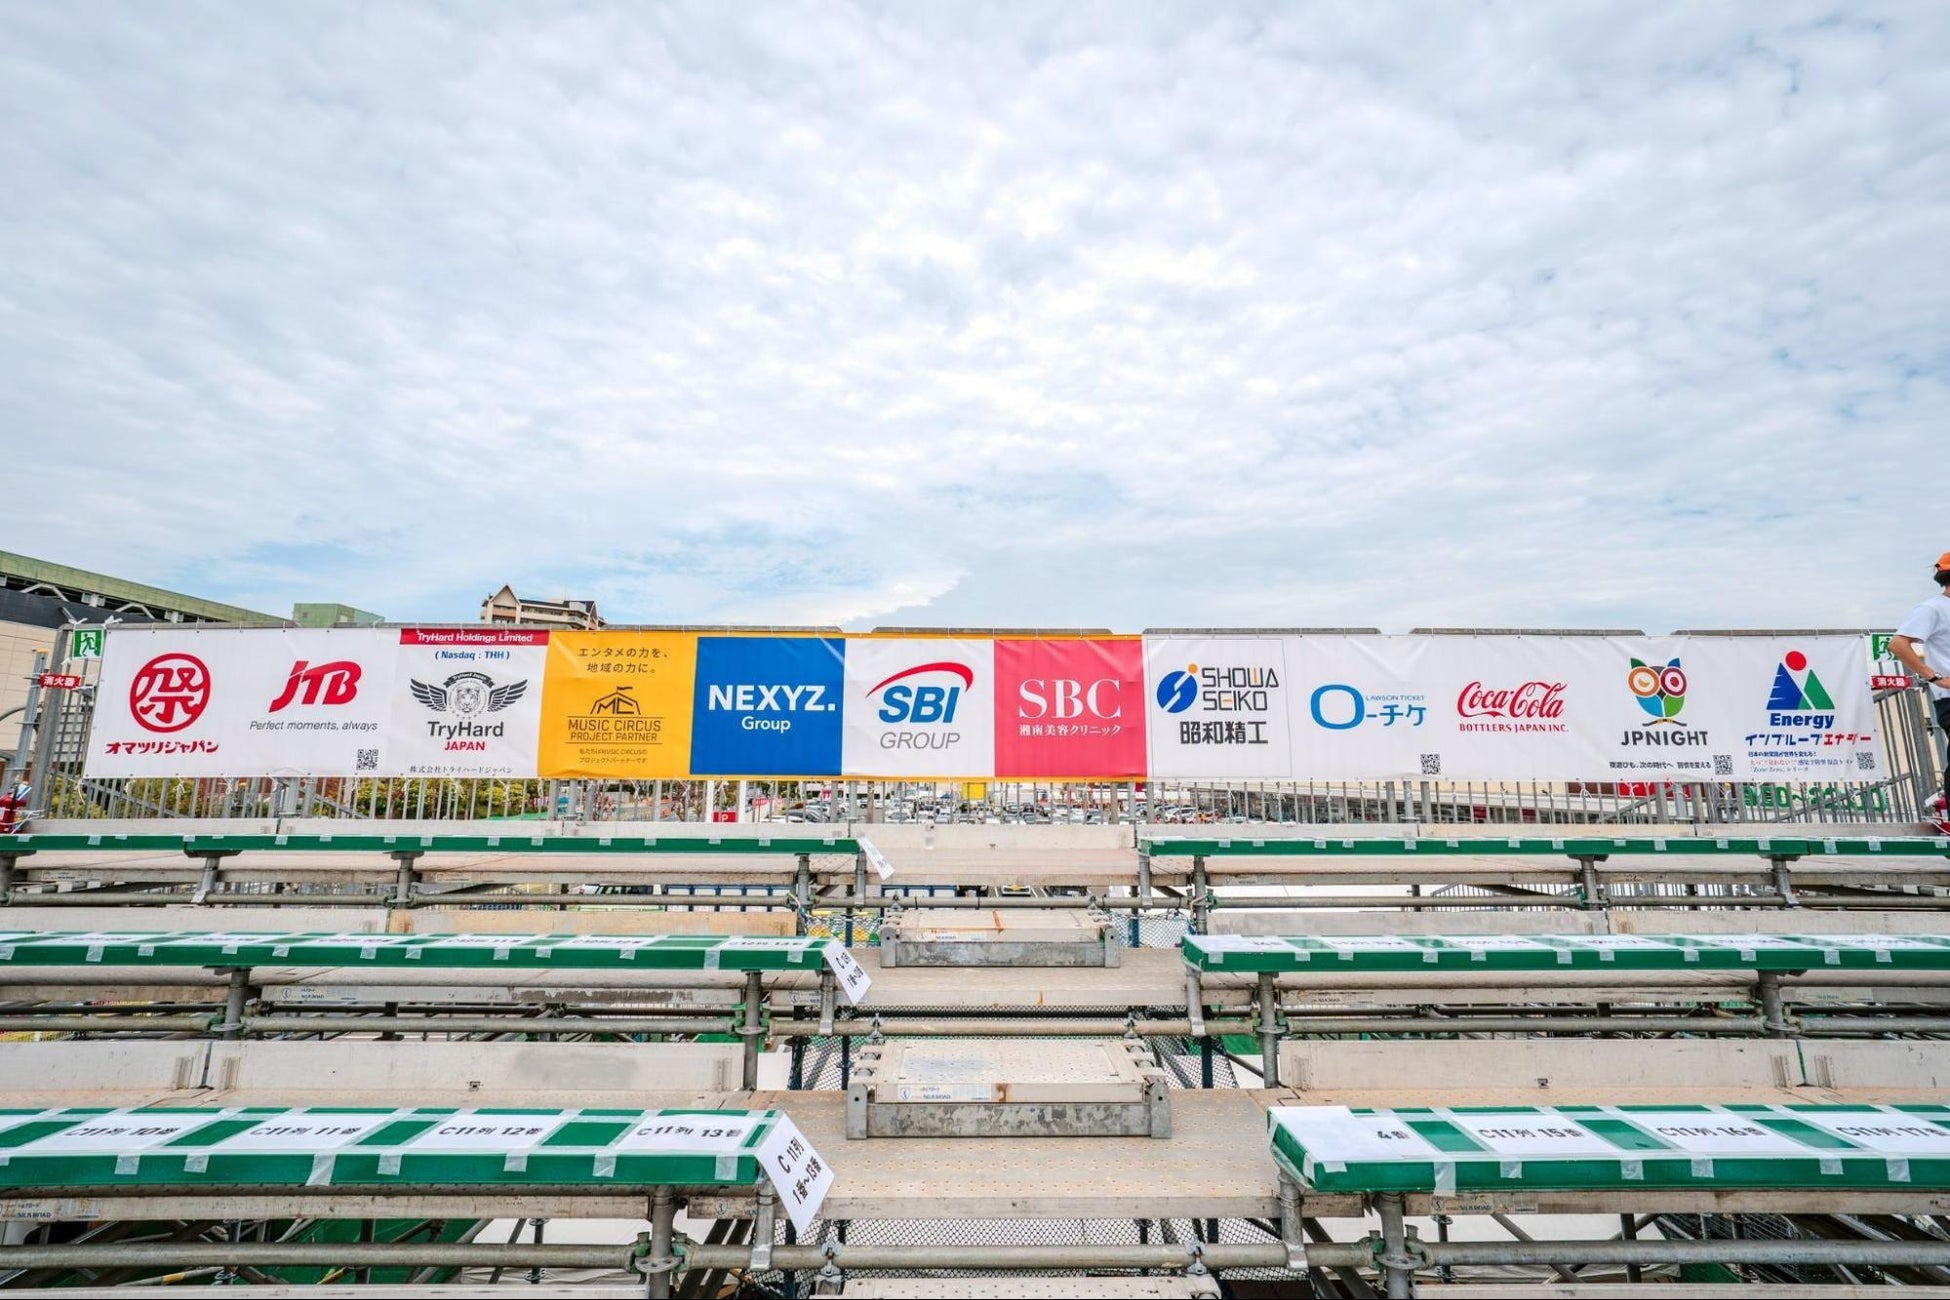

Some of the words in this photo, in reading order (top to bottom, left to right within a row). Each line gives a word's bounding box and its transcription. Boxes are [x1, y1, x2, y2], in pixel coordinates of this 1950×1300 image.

[417, 632, 454, 643] TryHard
[456, 634, 497, 643] Holdings
[499, 634, 533, 642] Limited
[579, 647, 668, 658] エンタメの力を、
[586, 663, 656, 673] 地域の力に。
[43, 675, 76, 687] 消火器
[1202, 667, 1279, 688] SHOWA
[1877, 677, 1905, 687] 消火器
[269, 660, 362, 713] JTB
[139, 667, 203, 723] 祭
[708, 685, 836, 711] NEXYZ.
[1018, 679, 1121, 719] SBC
[1203, 690, 1268, 711] SEIKO
[1457, 681, 1568, 718] Coca-Cola
[878, 686, 960, 724] SBI
[249, 721, 284, 731] Perfect
[287, 721, 339, 731] moments,
[342, 721, 378, 733] always
[568, 719, 609, 731] MUSIC
[614, 720, 662, 732] CIRCUS
[741, 717, 791, 733] Group
[1459, 723, 1512, 732] BOTTLERS
[1514, 723, 1546, 733] JAPAN
[1548, 724, 1569, 732] INC.
[1769, 713, 1835, 729] Energy
[427, 721, 504, 740] TryHard
[570, 732, 612, 741] PROJECT
[616, 733, 657, 741] PARTNER
[1019, 724, 1121, 736] 湘南美容クリニック
[1180, 721, 1268, 744] 昭和精工
[444, 741, 486, 751] JAPAN
[879, 732, 961, 750] GROUP
[1621, 731, 1708, 746] JPNIGHT
[105, 739, 219, 754] オマツリジャパン
[410, 765, 513, 774] 株式会社トライハードジャパン
